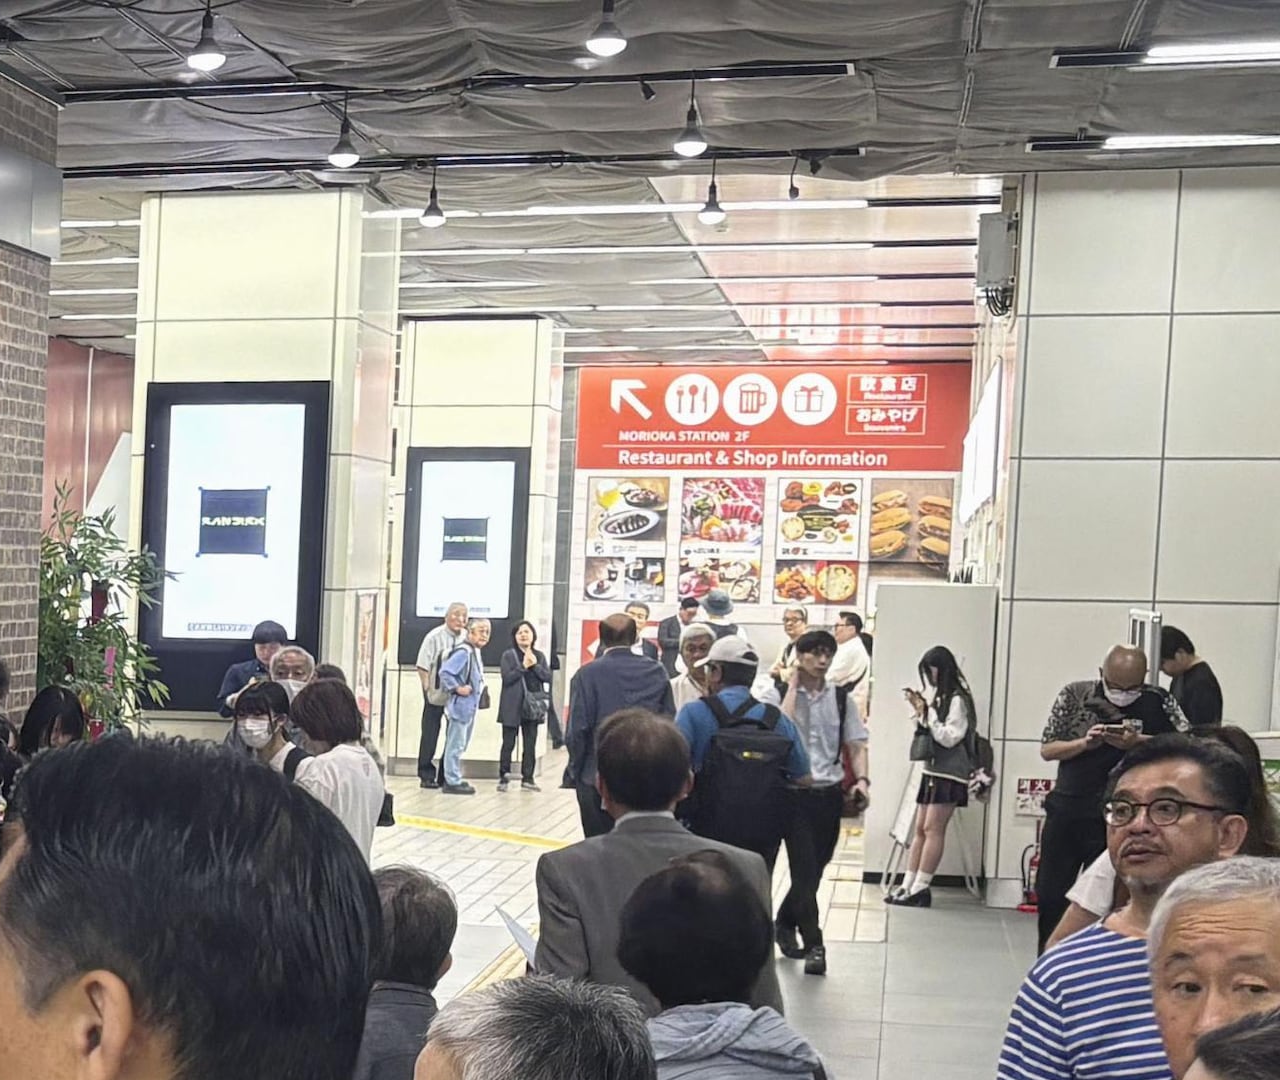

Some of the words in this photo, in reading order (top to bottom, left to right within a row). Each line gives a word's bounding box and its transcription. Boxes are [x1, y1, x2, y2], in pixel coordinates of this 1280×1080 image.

[856, 408, 918, 423] おみやげ
[619, 431, 676, 442] MORIOKA
[678, 431, 730, 442] STATION
[734, 430, 751, 442] 2F
[618, 450, 712, 467] Restaurant
[716, 451, 729, 466] &
[733, 450, 778, 470] Shop
[782, 450, 888, 467] Information
